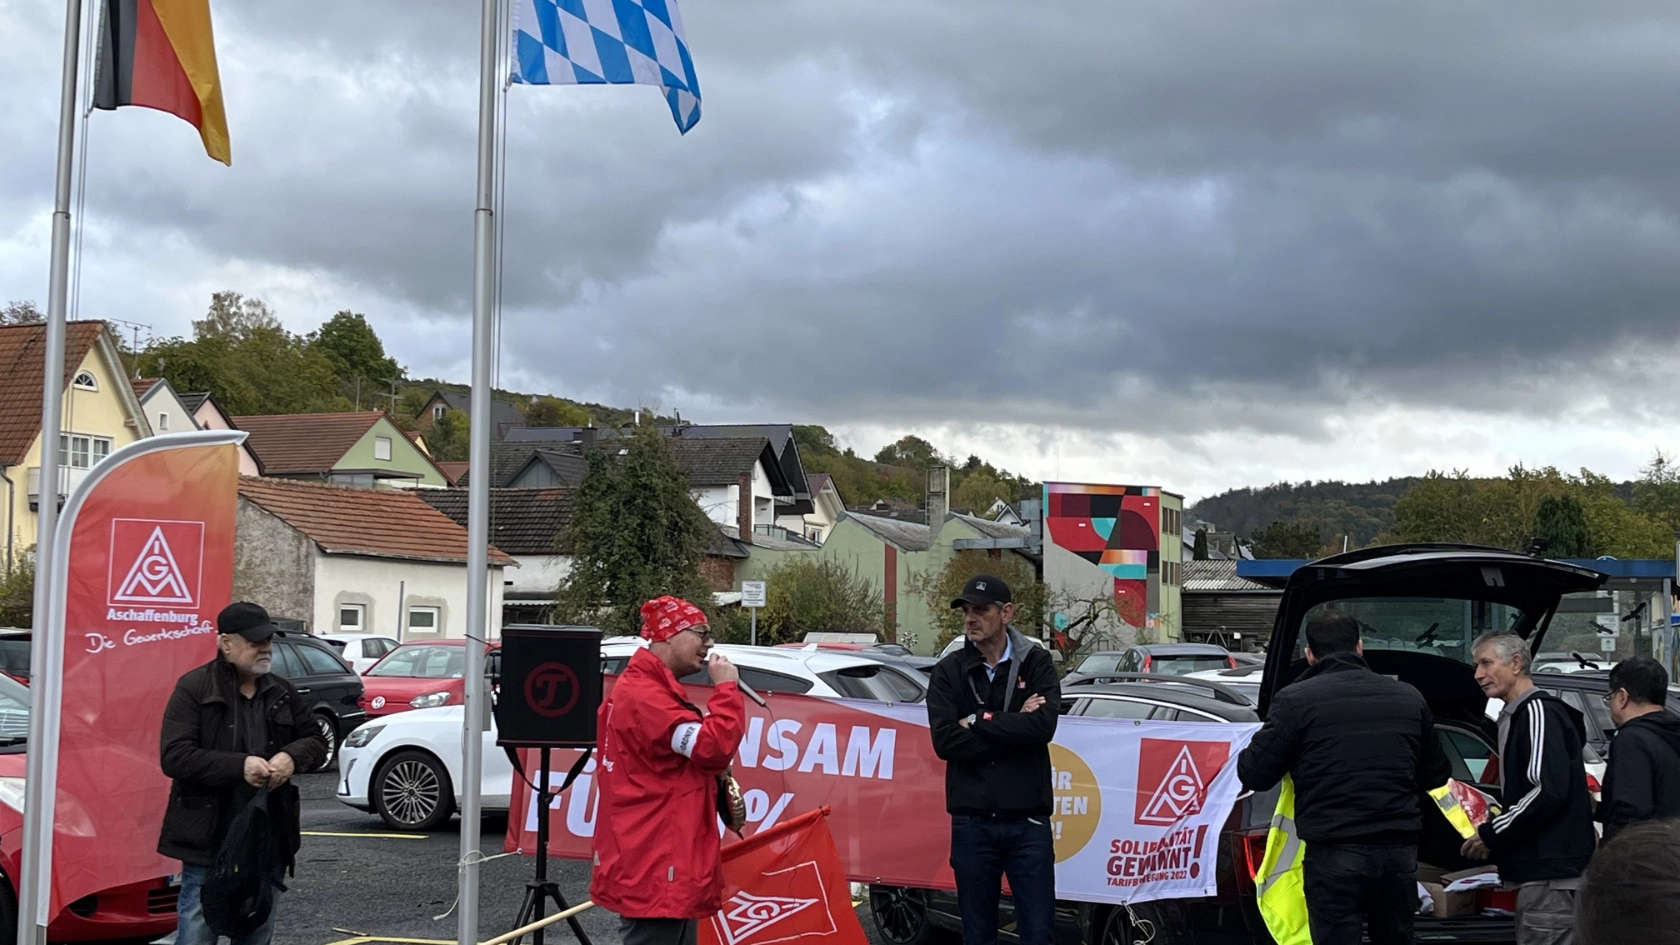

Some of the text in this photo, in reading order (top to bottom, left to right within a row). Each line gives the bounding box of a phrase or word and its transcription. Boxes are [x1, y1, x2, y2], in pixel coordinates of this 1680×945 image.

[106, 608, 198, 626] Aschaffenburg
[85, 632, 116, 653] Die
[737, 716, 897, 781] NSAM
[1053, 796, 1088, 815] TEN
[1170, 870, 1188, 881] 2022
